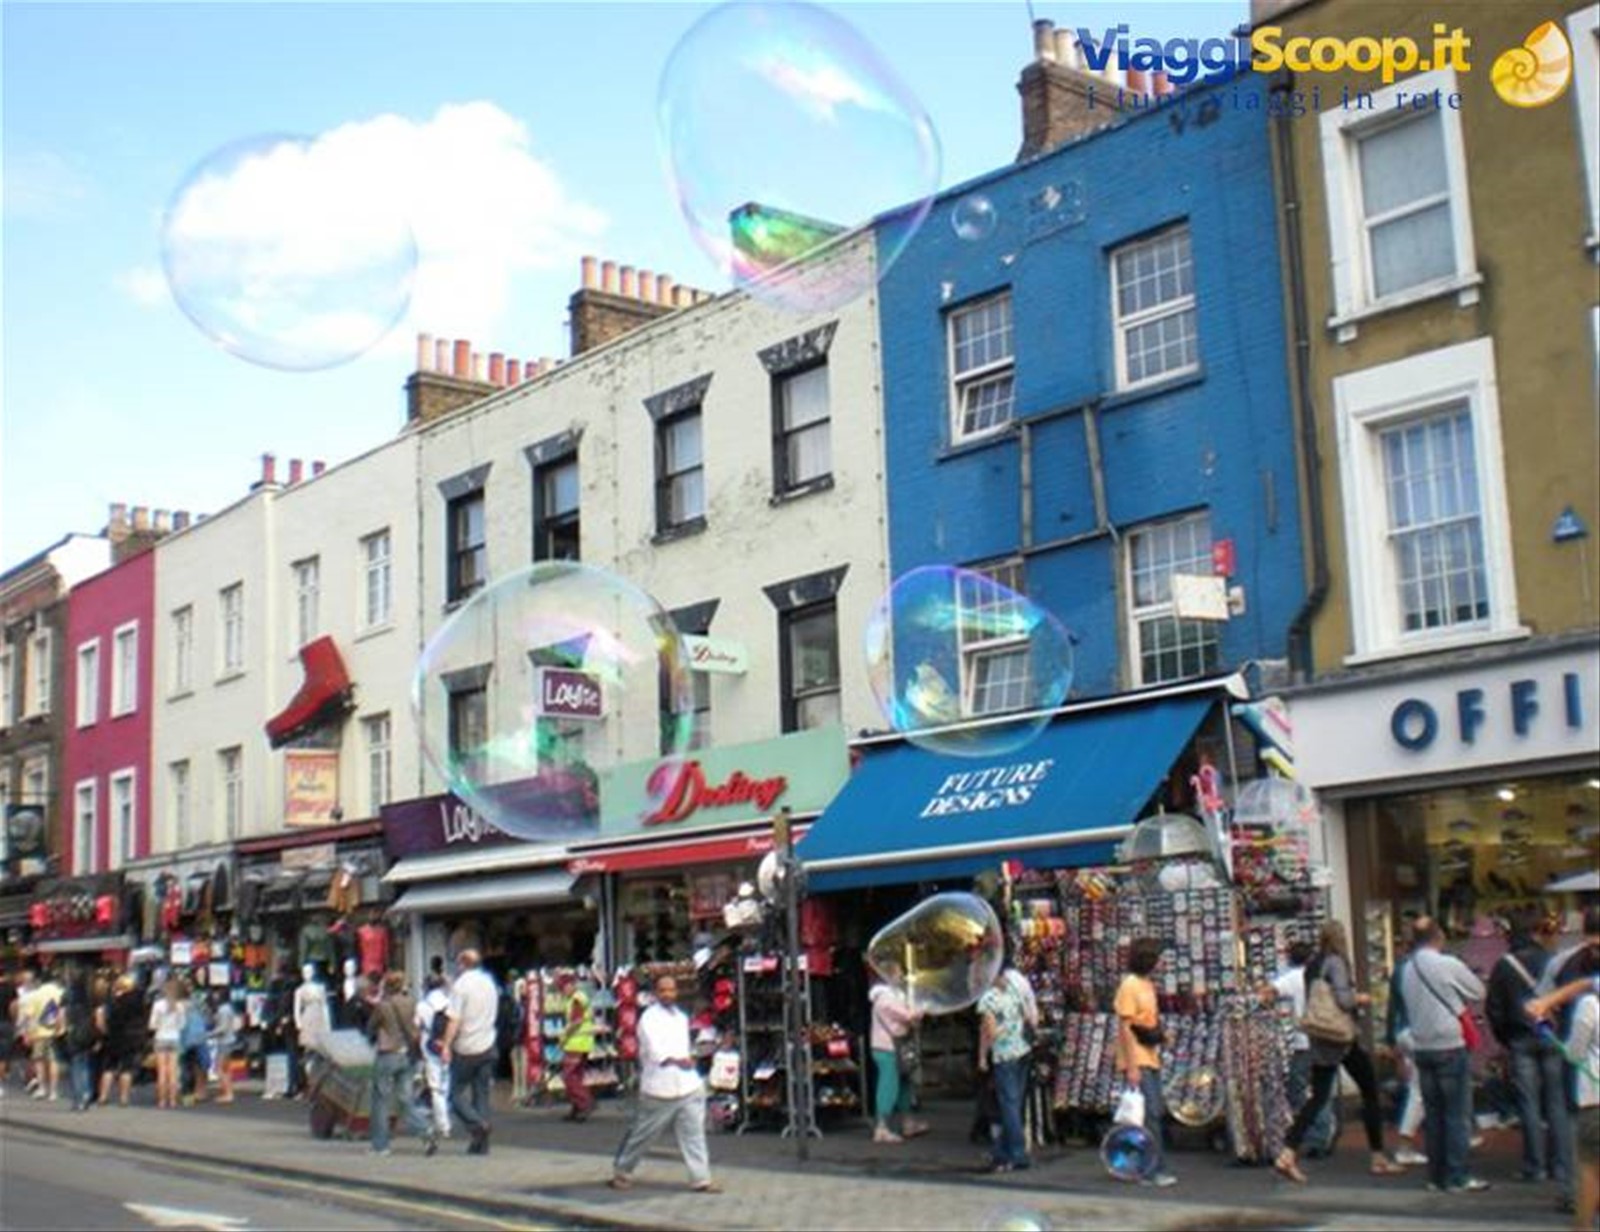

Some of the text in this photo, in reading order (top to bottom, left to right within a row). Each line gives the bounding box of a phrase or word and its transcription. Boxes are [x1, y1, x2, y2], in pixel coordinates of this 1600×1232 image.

[1390, 673, 1582, 751] OFFI
[938, 758, 1055, 795] FUTURE
[920, 782, 1038, 818] DESIGNS
